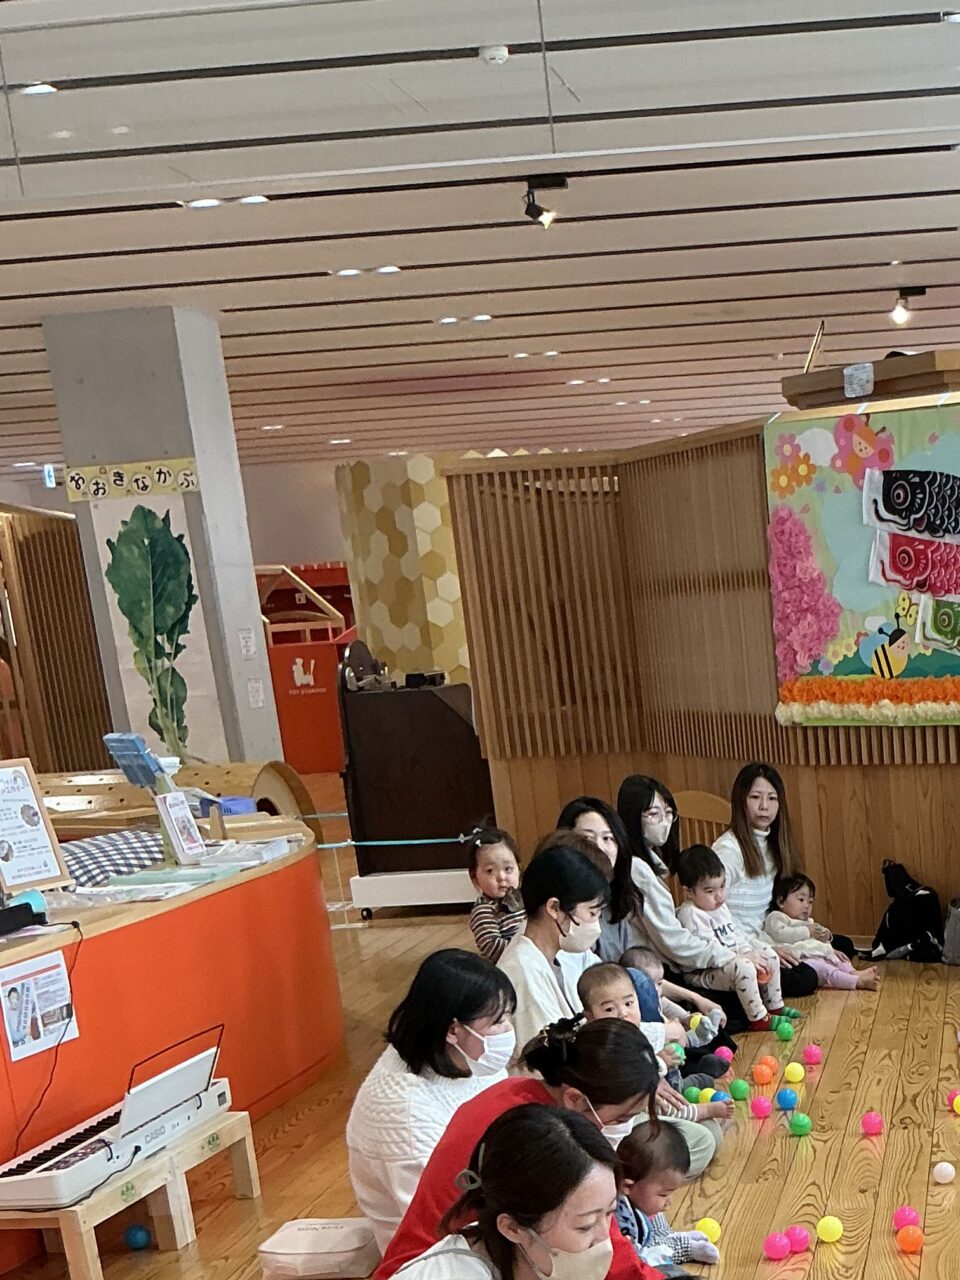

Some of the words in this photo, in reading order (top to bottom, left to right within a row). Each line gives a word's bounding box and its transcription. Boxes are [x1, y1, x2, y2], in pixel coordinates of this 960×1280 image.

[69, 467, 195, 496] おおきなかぶ
[144, 1125, 166, 1144] CASIO
